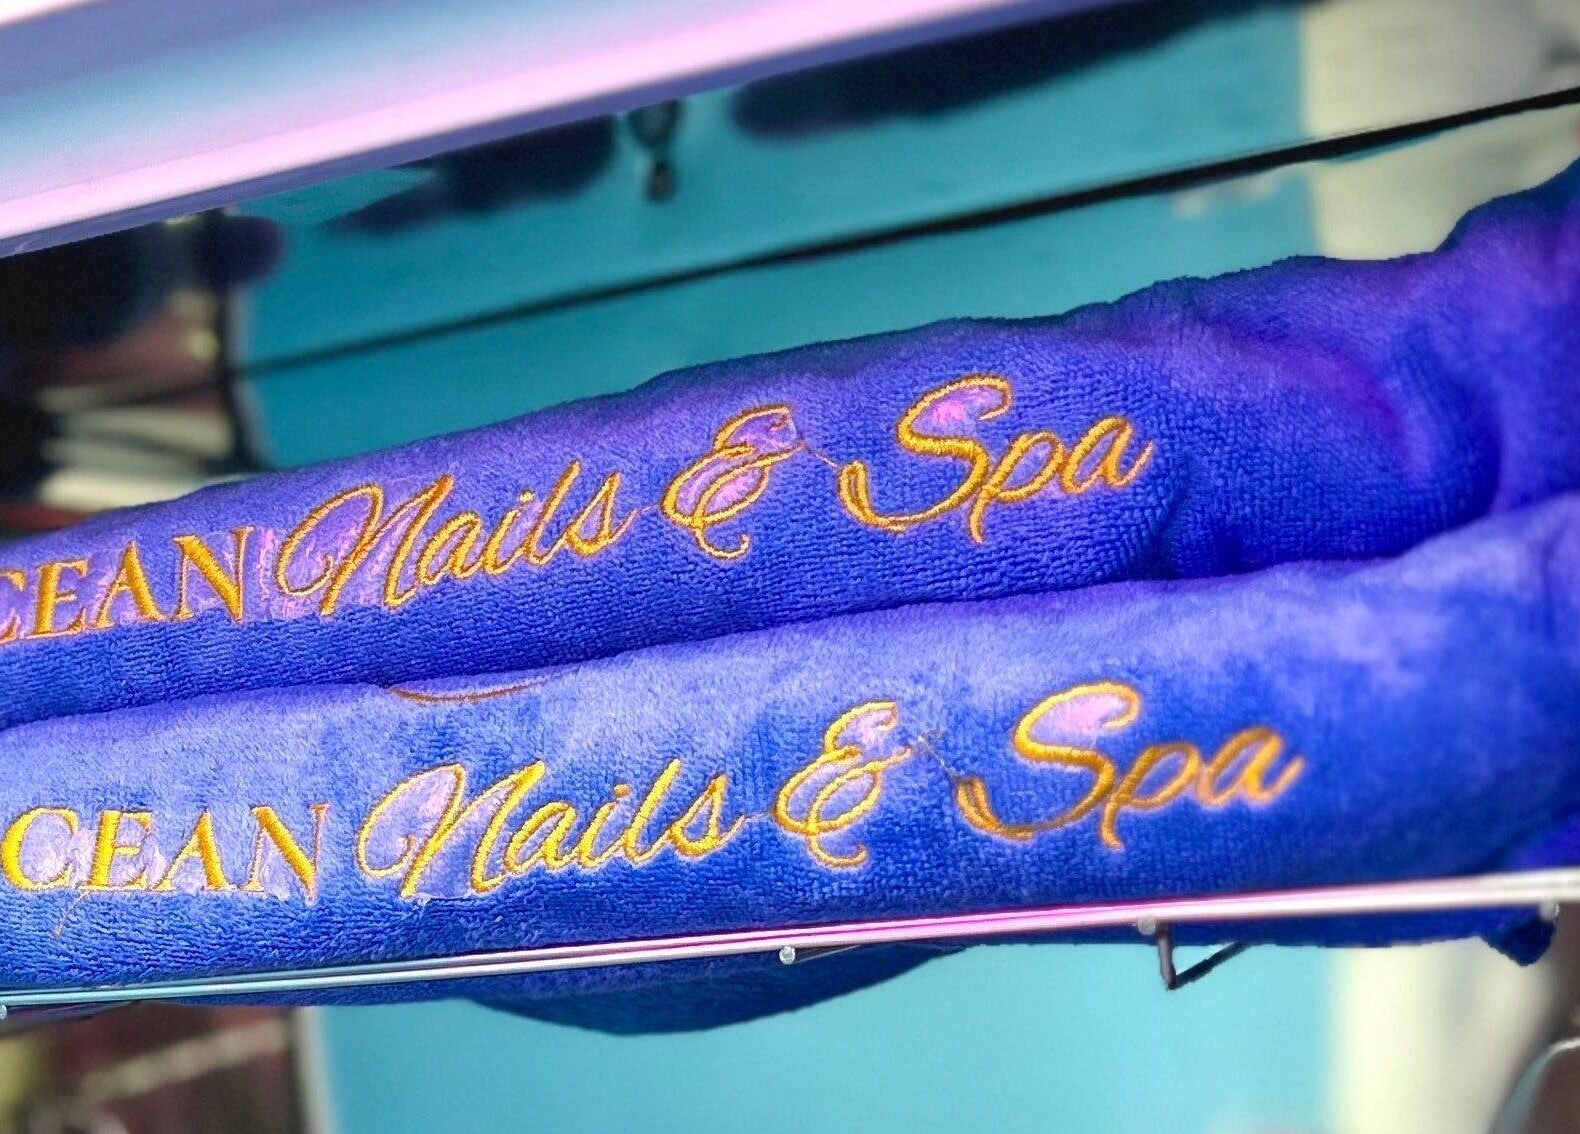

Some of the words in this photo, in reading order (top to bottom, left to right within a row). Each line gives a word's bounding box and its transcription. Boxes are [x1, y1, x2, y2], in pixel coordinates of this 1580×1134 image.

[275, 460, 643, 616] Nails
[662, 405, 802, 561] &
[838, 374, 1153, 543] Spa
[356, 759, 748, 900] Nails
[775, 701, 912, 868] &
[957, 680, 1306, 850] Spa
